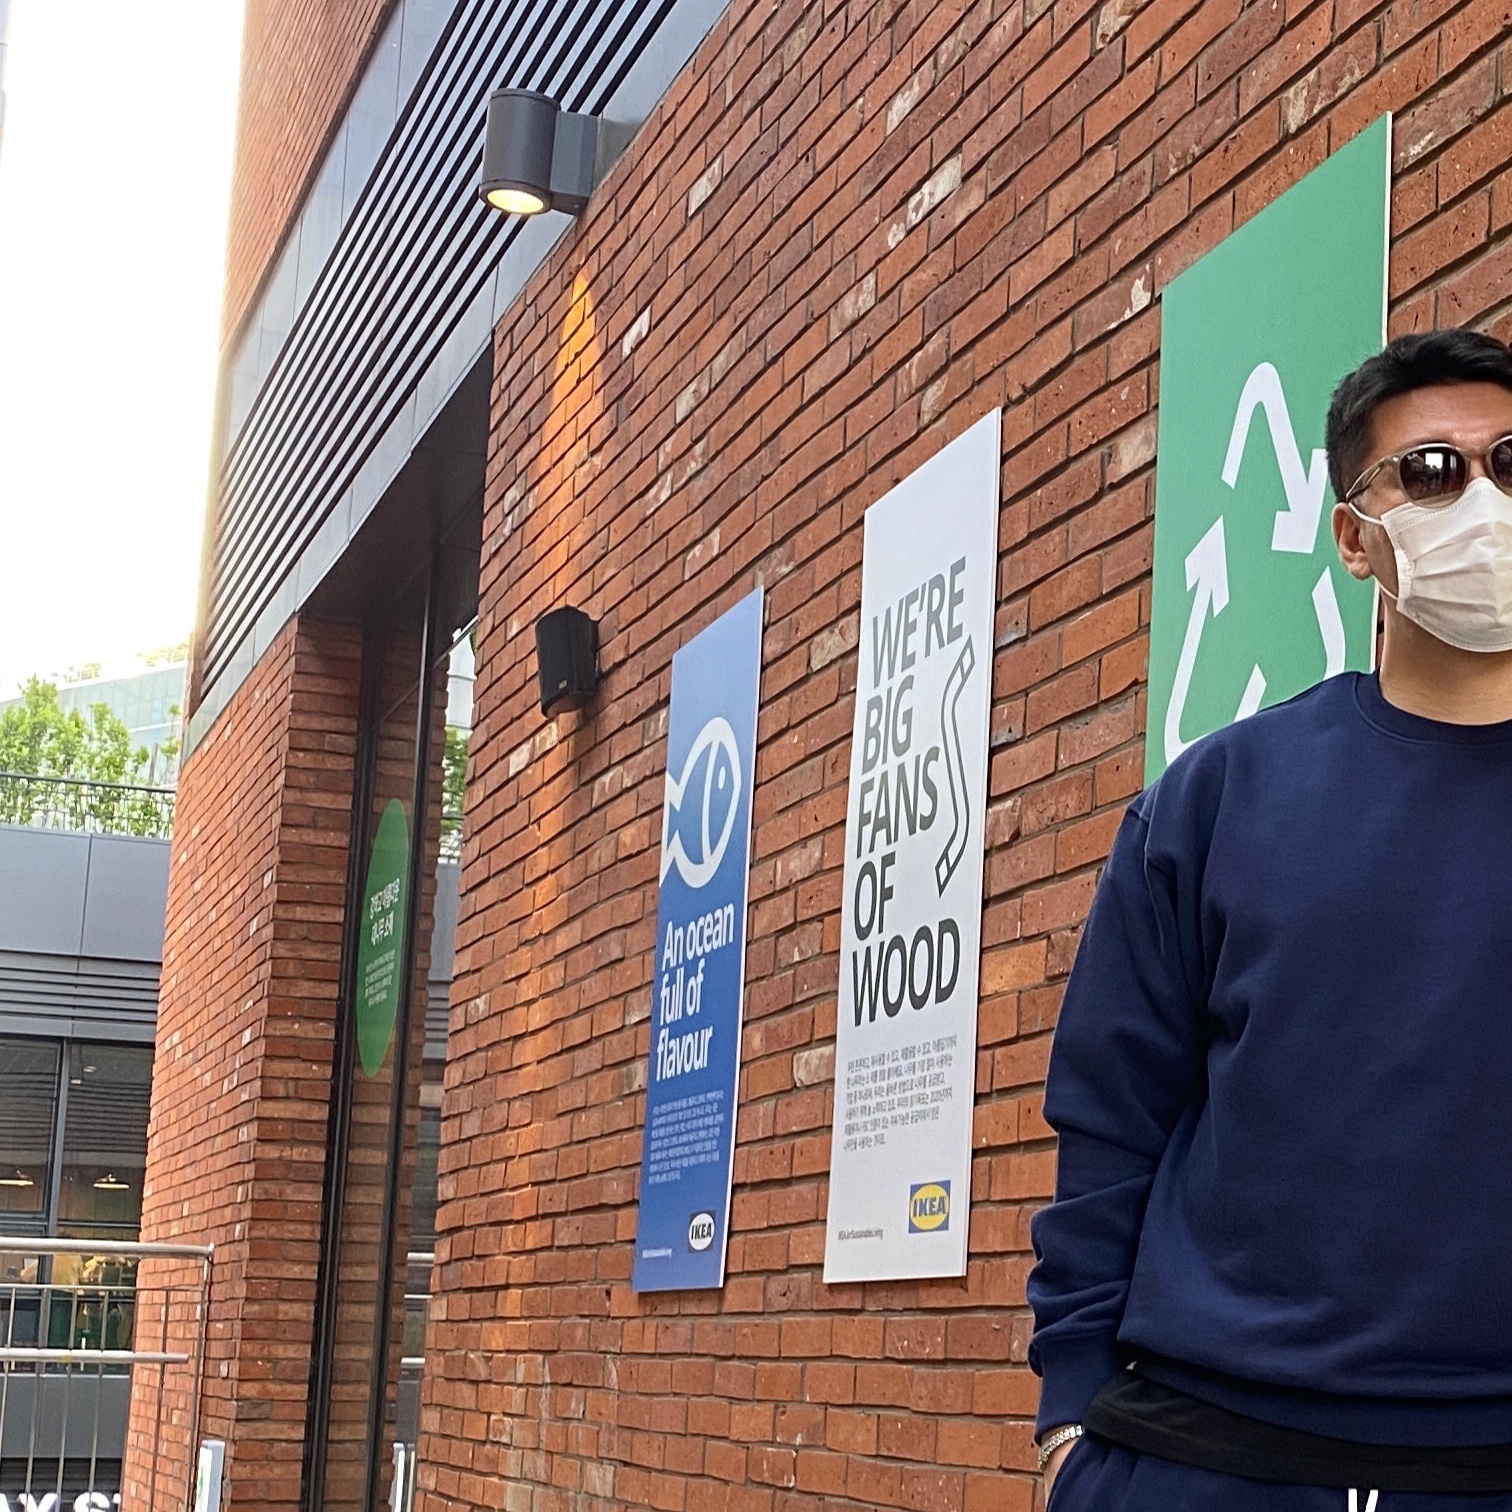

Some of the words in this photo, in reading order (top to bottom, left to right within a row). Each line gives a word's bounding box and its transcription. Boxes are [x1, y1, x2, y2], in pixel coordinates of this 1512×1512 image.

[872, 555, 967, 690] WE'RE
[861, 674, 915, 776] BIG
[856, 745, 941, 860] FANS
[854, 850, 897, 942] OF
[661, 920, 684, 972] An
[686, 903, 735, 962] ocean
[852, 917, 961, 1028] WOOD
[659, 966, 685, 1026] full
[686, 957, 706, 1017] of
[656, 1024, 714, 1082] flavour
[690, 1222, 713, 1241] IKEA
[912, 1195, 948, 1218] IKEA
